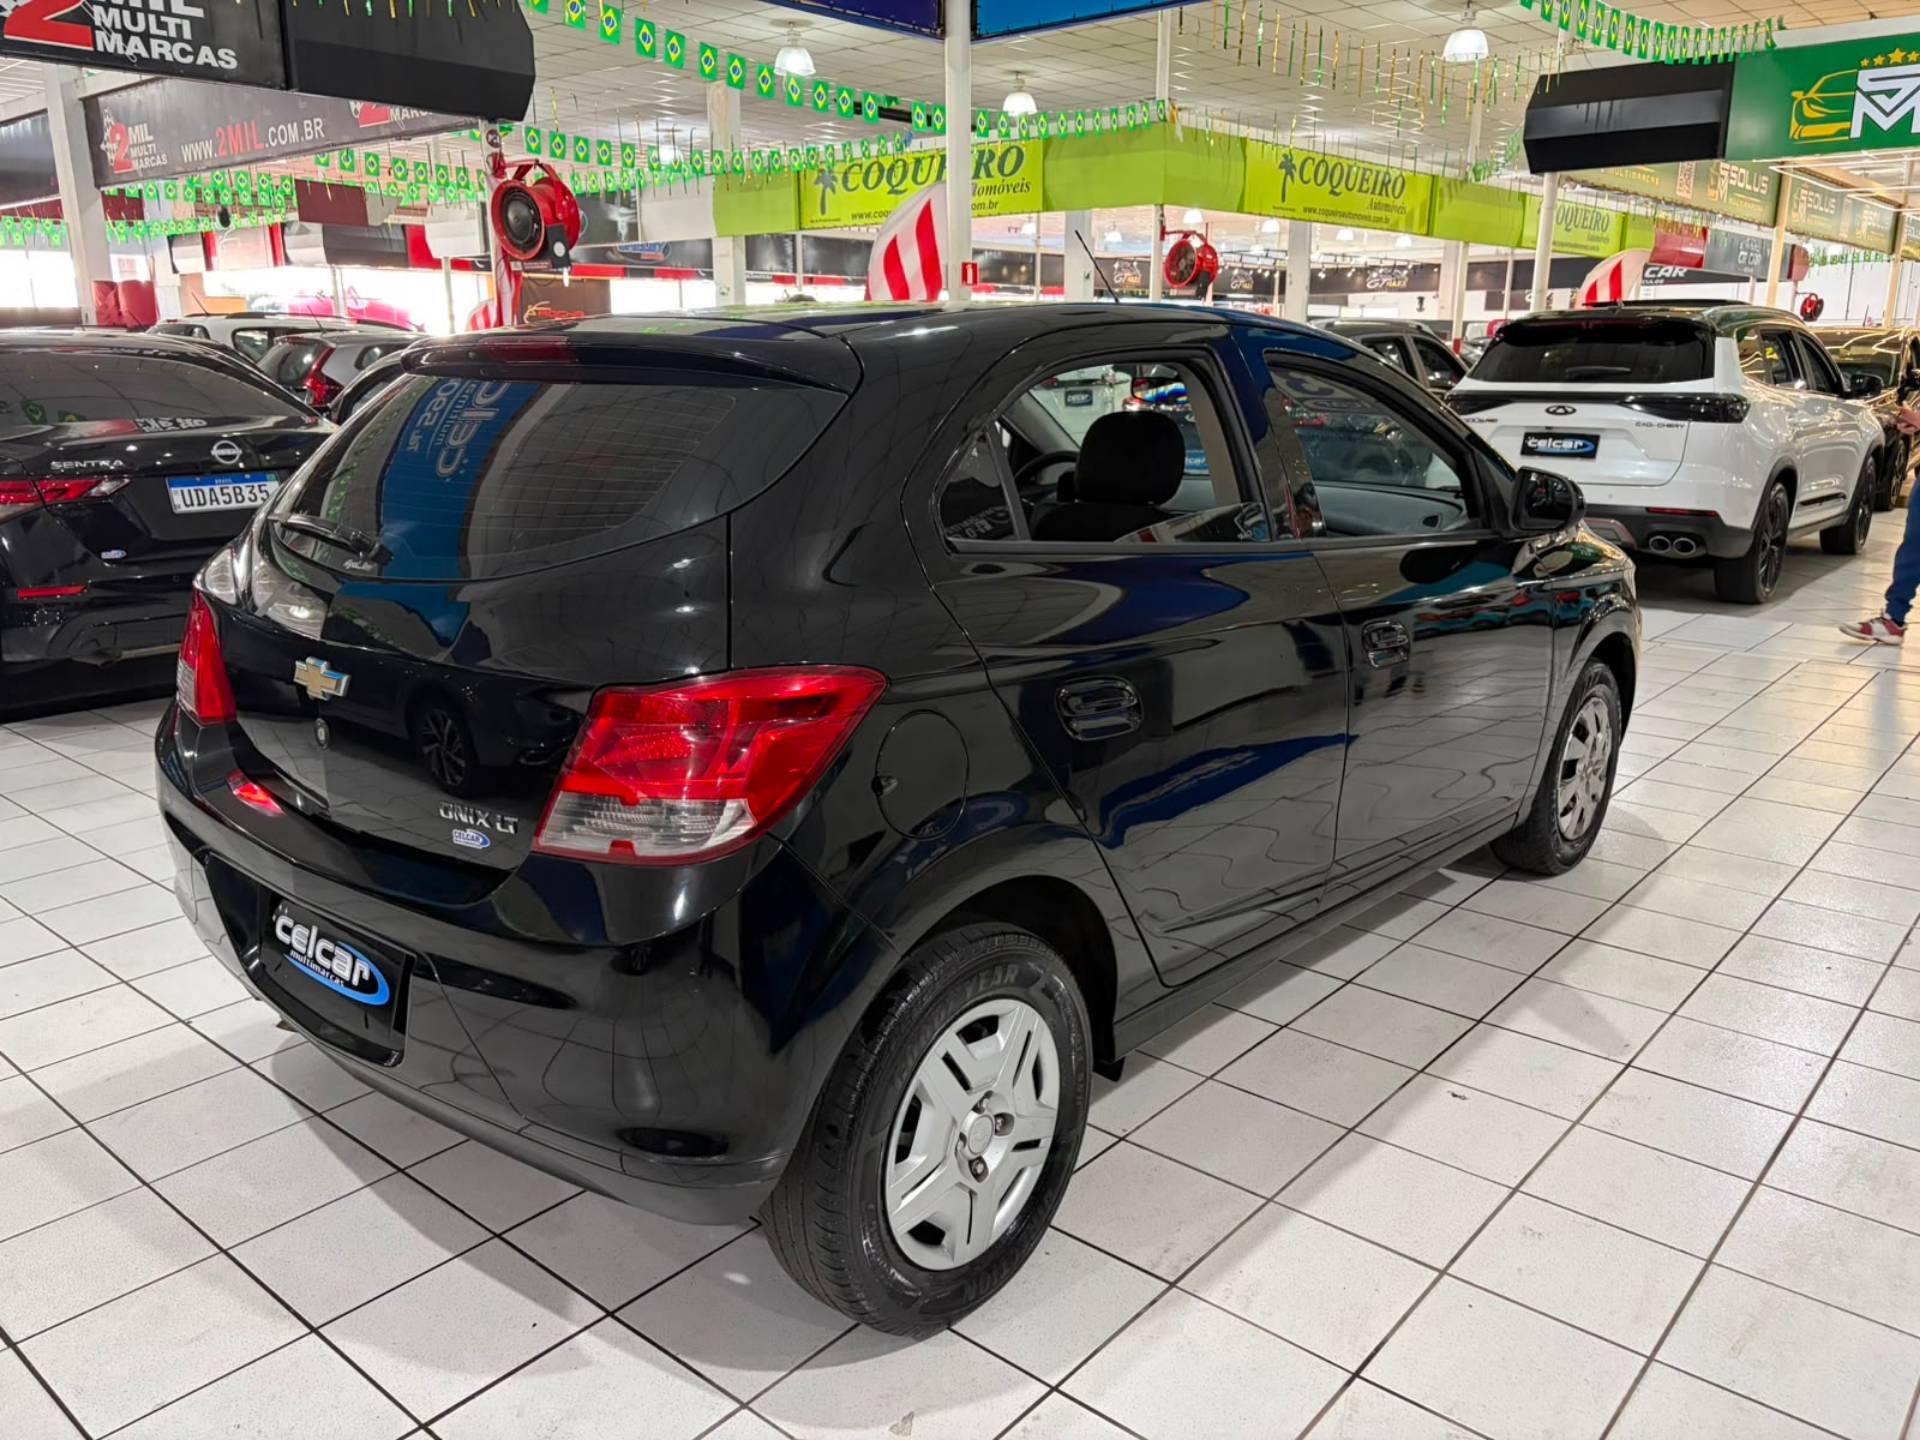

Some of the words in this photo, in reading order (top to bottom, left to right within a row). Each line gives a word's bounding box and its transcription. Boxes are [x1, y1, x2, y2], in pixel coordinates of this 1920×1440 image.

[94, 5, 192, 40] MULTI
[95, 30, 238, 70] MARCAS
[128, 122, 154, 145] MIL
[1299, 156, 1406, 199] COQUEIRO
[1555, 203, 1610, 233] OQUEIRO
[1644, 266, 1688, 278] CAR
[1526, 436, 1584, 449] celcar
[180, 483, 270, 508] UDA5B35
[440, 801, 491, 828] ONIX
[495, 814, 519, 834] LT
[275, 914, 371, 987] celcar
[289, 949, 345, 988] multimarcas
